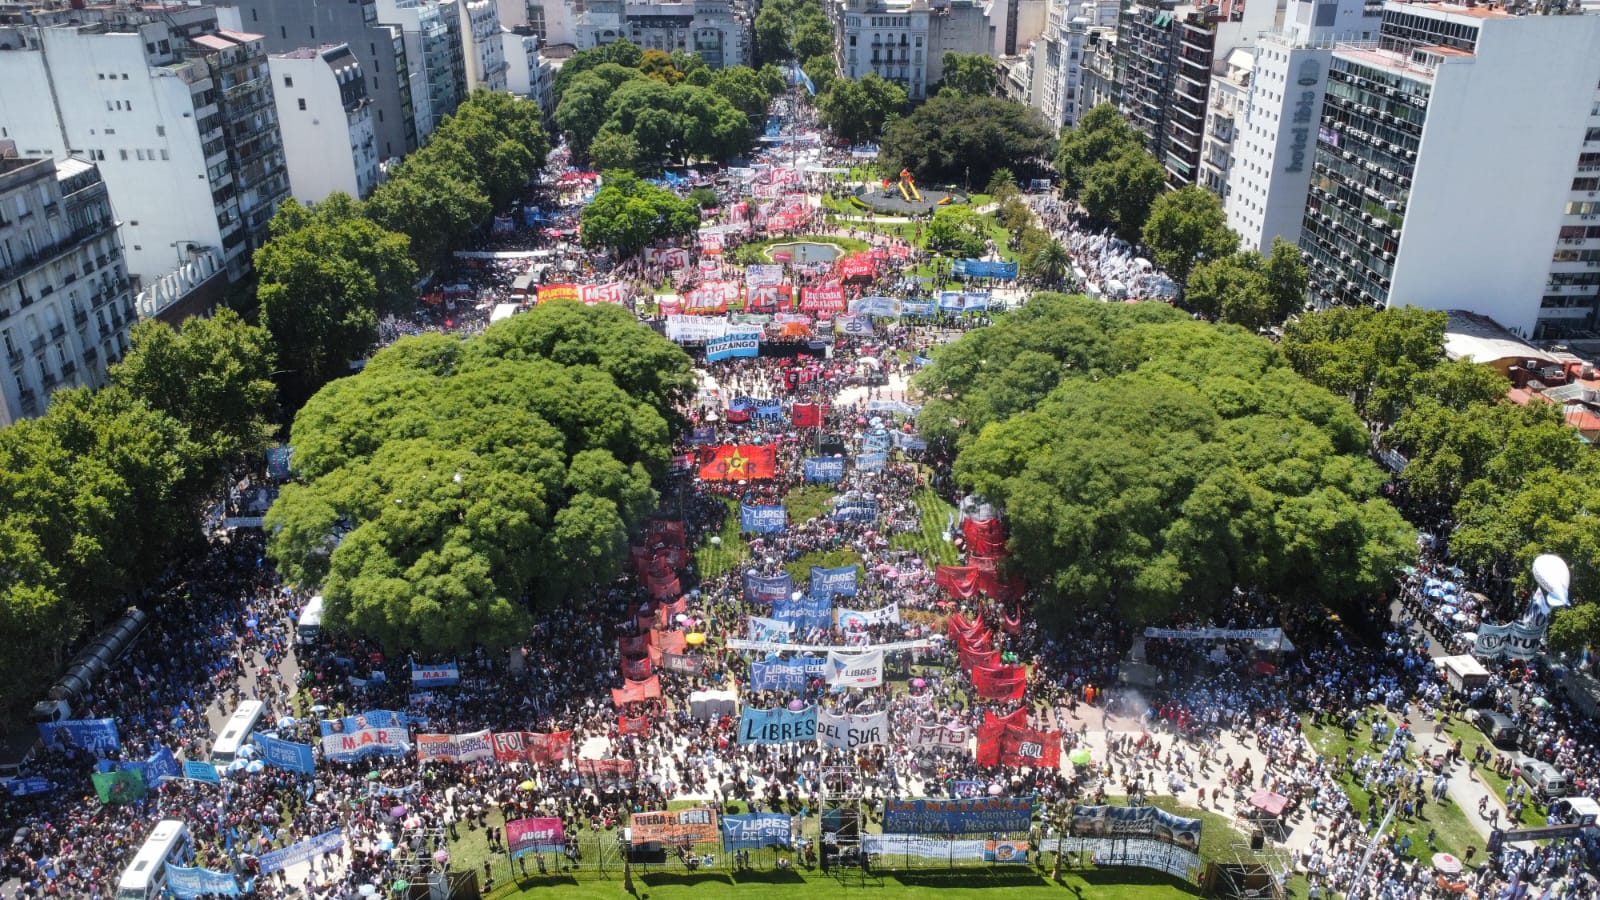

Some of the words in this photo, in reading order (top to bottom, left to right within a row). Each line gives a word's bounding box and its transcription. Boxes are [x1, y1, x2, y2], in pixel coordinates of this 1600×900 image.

[1285, 128, 1309, 173] hotel
[584, 285, 621, 303] MST
[815, 461, 843, 470] LIBRES
[753, 510, 785, 519] LIBRES
[823, 571, 857, 583] LIBRES
[758, 583, 787, 594] LIBRES
[765, 664, 804, 674] LIBRES
[845, 666, 877, 677] LIBRES
[764, 674, 783, 683] DEL
[784, 675, 803, 684] SUR
[817, 721, 841, 740] DEL
[847, 726, 880, 748] SUR
[461, 742, 491, 754] SOCIAL
[888, 799, 915, 812] LA
[635, 814, 667, 826] FUERA
[679, 809, 712, 825] FMI
[742, 818, 789, 831] LIBRES
[741, 831, 763, 841] DEL
